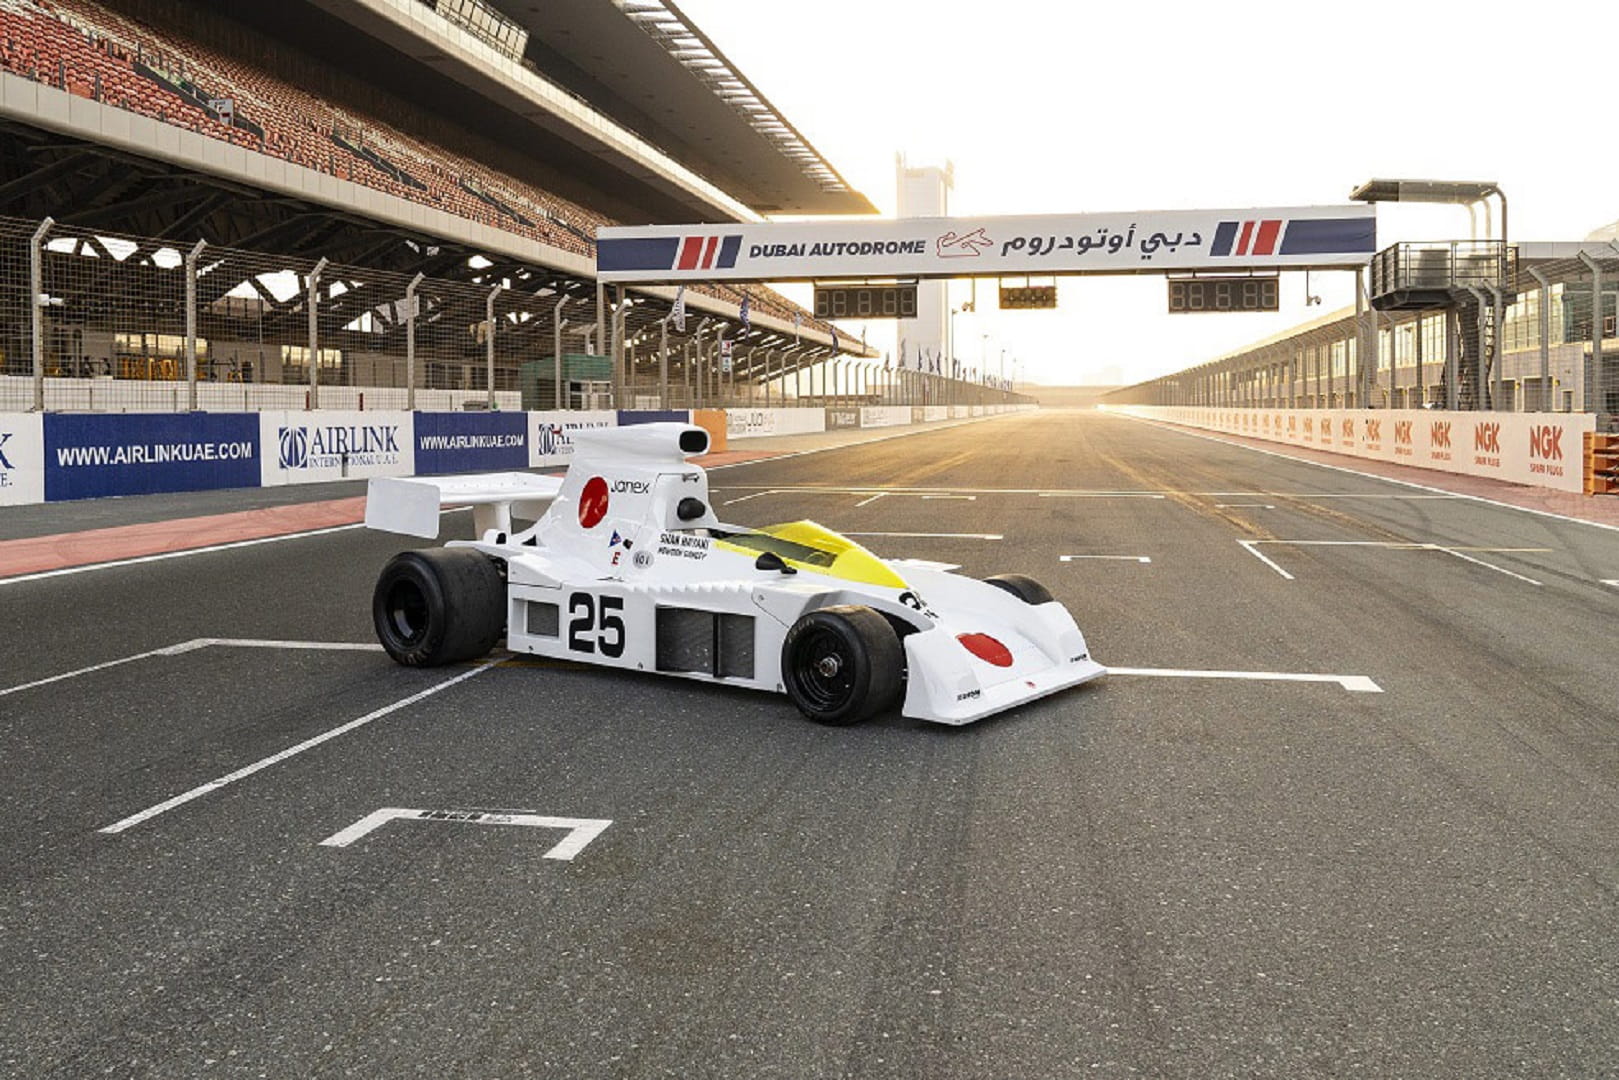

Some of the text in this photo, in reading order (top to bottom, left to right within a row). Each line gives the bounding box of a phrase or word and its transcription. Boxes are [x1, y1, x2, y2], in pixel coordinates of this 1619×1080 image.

[750, 240, 927, 258] DUBAI AUTODROME
[1000, 223, 1201, 260] دبي أوتودروم
[311, 426, 399, 455] AIRLINK
[420, 434, 525, 450] WWW.AIRLINKUAE.COM
[1431, 421, 1452, 449] NGK
[1475, 422, 1500, 454] NGK
[1530, 425, 1564, 461] NGK
[57, 442, 253, 467] WWW.AIRLINKUAE.COM
[309, 455, 374, 468] INTERNIONAL
[1530, 463, 1564, 477] SPARK PLUGS
[569, 592, 626, 658] 25
